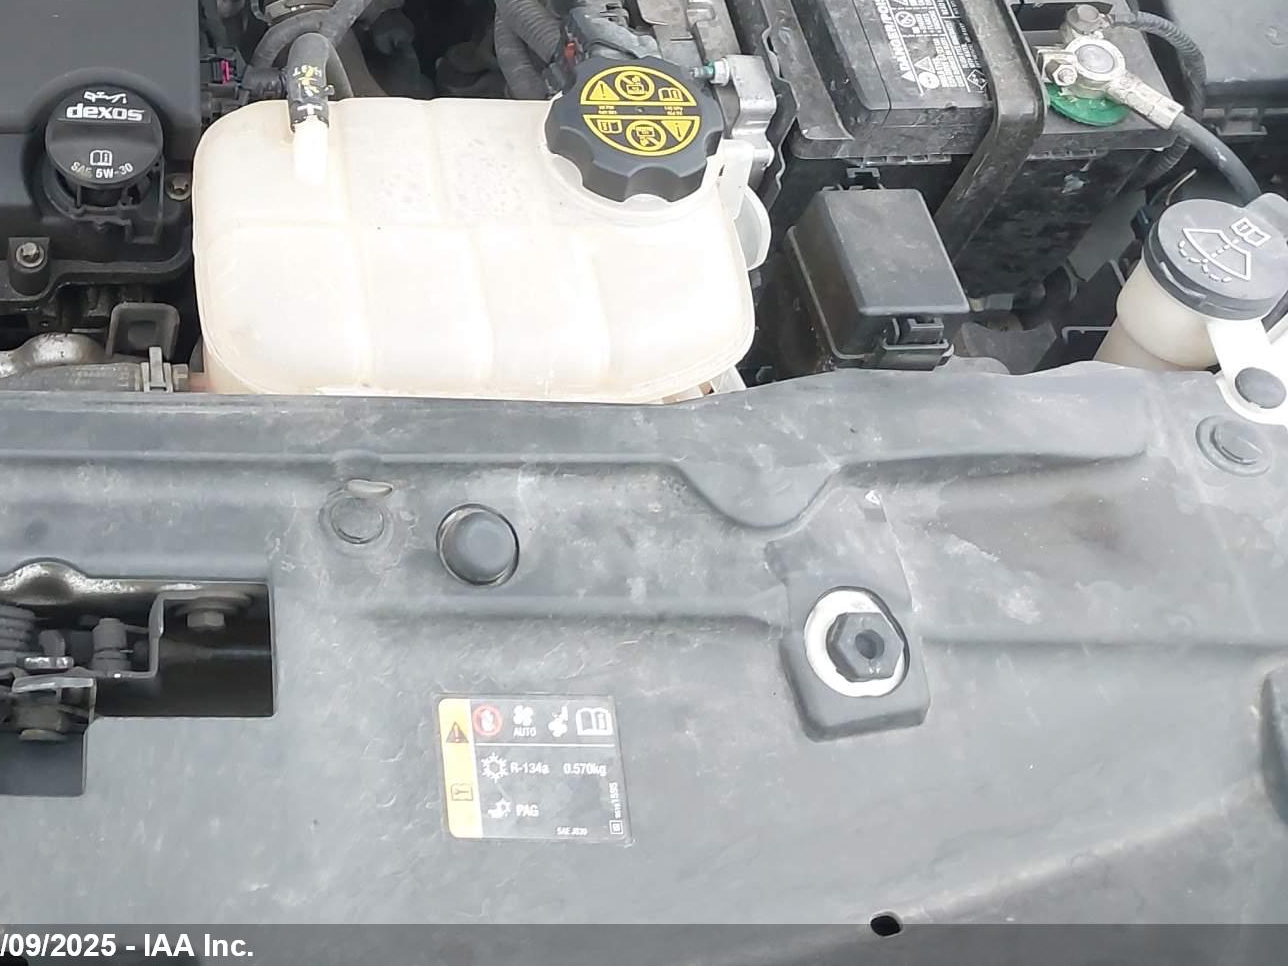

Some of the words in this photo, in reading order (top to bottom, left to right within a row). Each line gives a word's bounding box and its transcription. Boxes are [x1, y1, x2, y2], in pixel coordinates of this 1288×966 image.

[66, 103, 145, 122] dexos
[514, 727, 537, 737] AUTO
[511, 762, 550, 774] R-134a
[563, 762, 607, 777] 0.570kg
[516, 805, 540, 817] PAG
